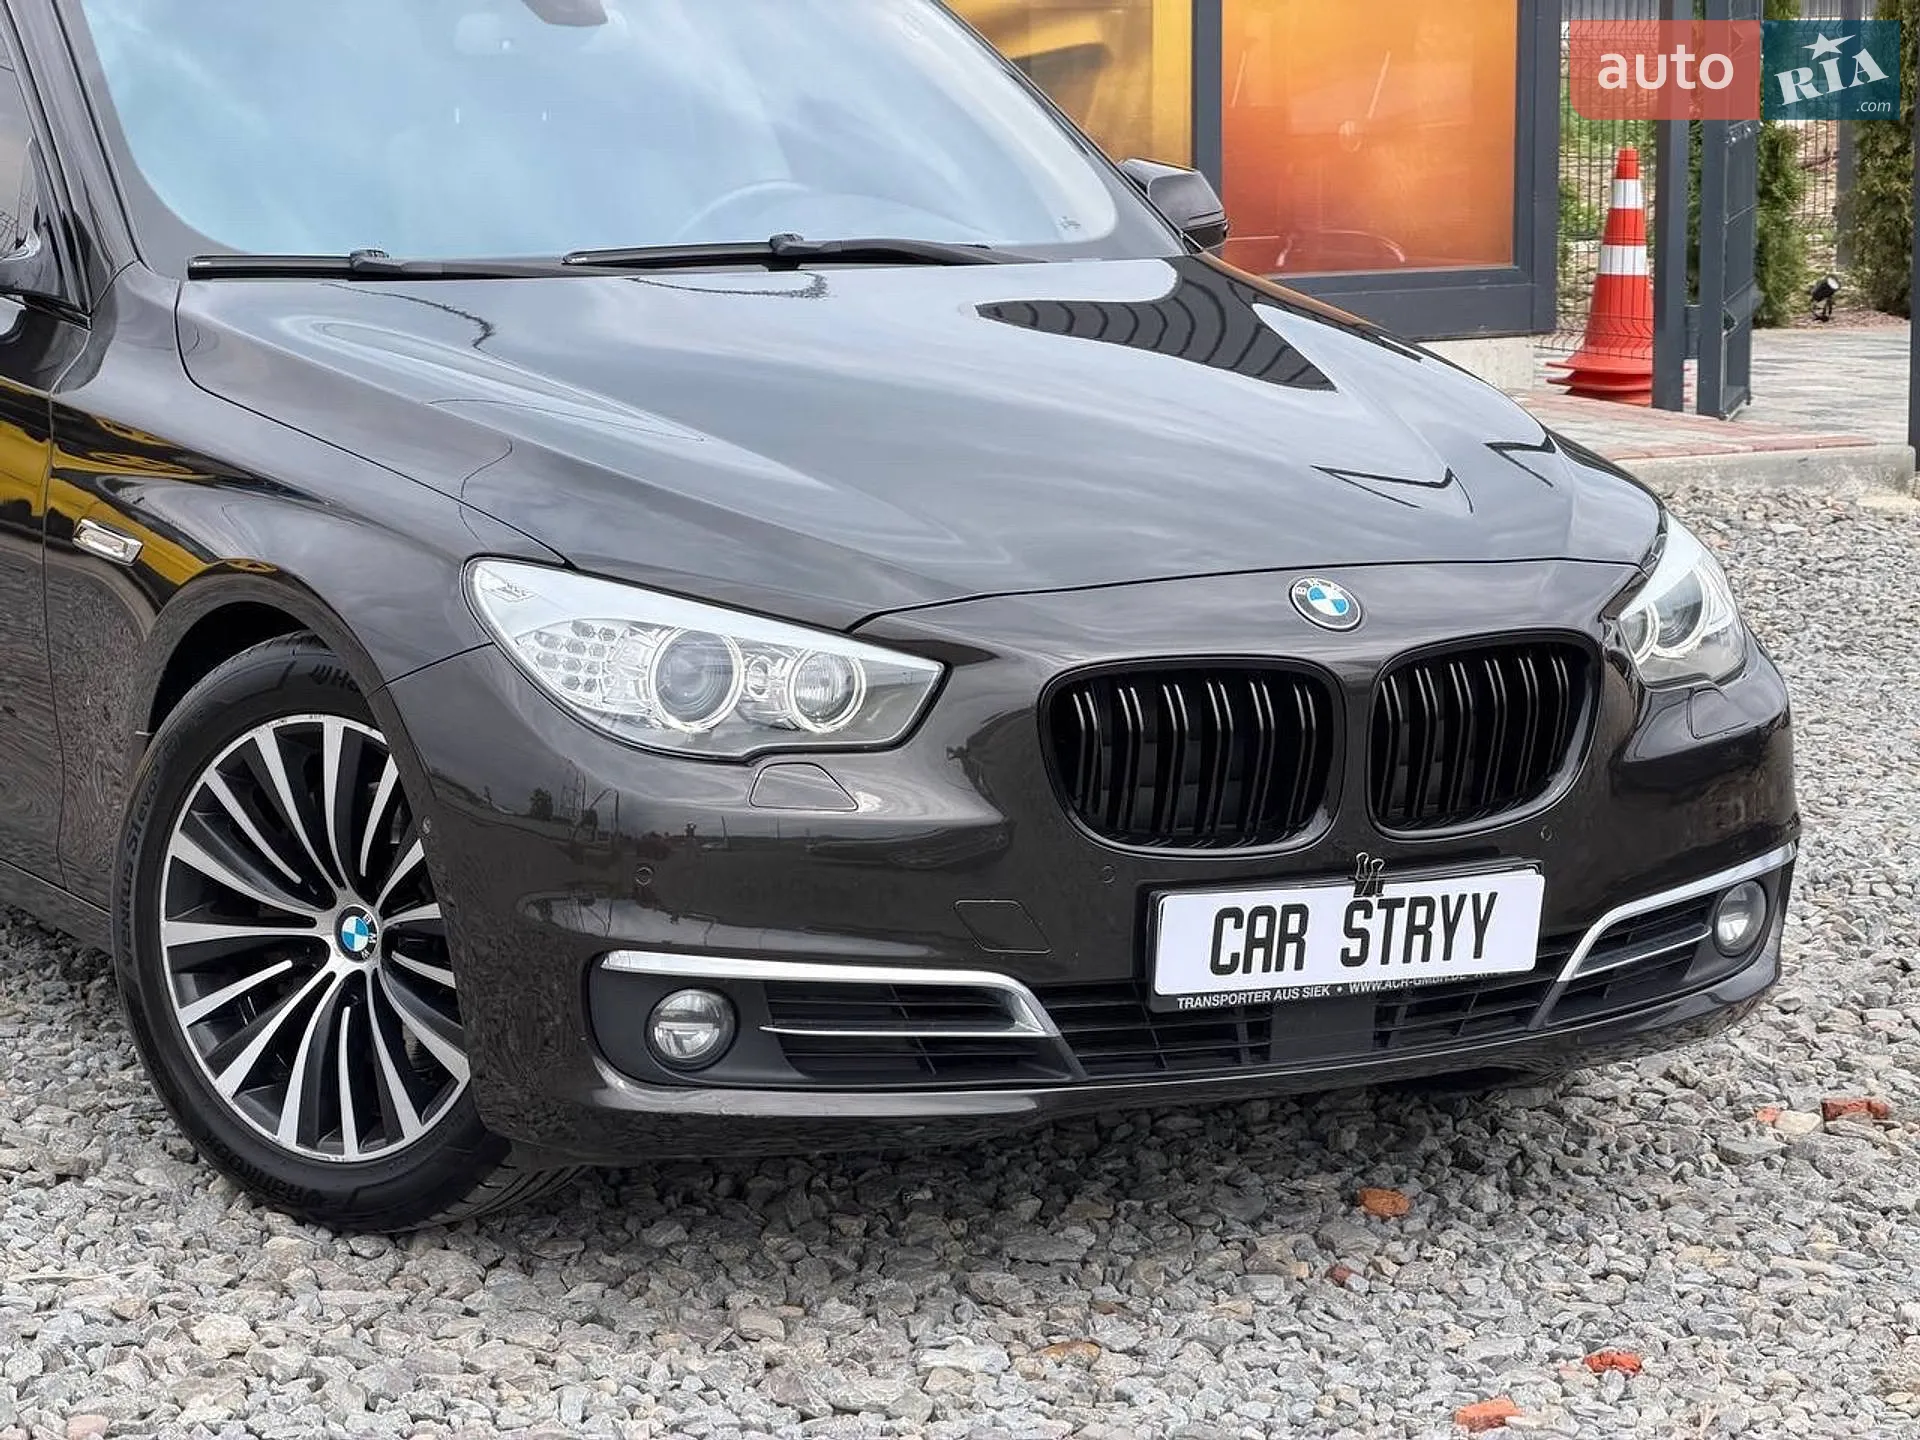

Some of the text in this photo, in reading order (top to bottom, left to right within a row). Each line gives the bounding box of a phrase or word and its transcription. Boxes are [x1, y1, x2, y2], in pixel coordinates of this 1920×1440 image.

[1210, 891, 1499, 977] CAR STRYY
[1177, 990, 1272, 1010] TRANSPORTER
[1273, 987, 1301, 1001] AUS
[1302, 985, 1331, 999] SIEK
